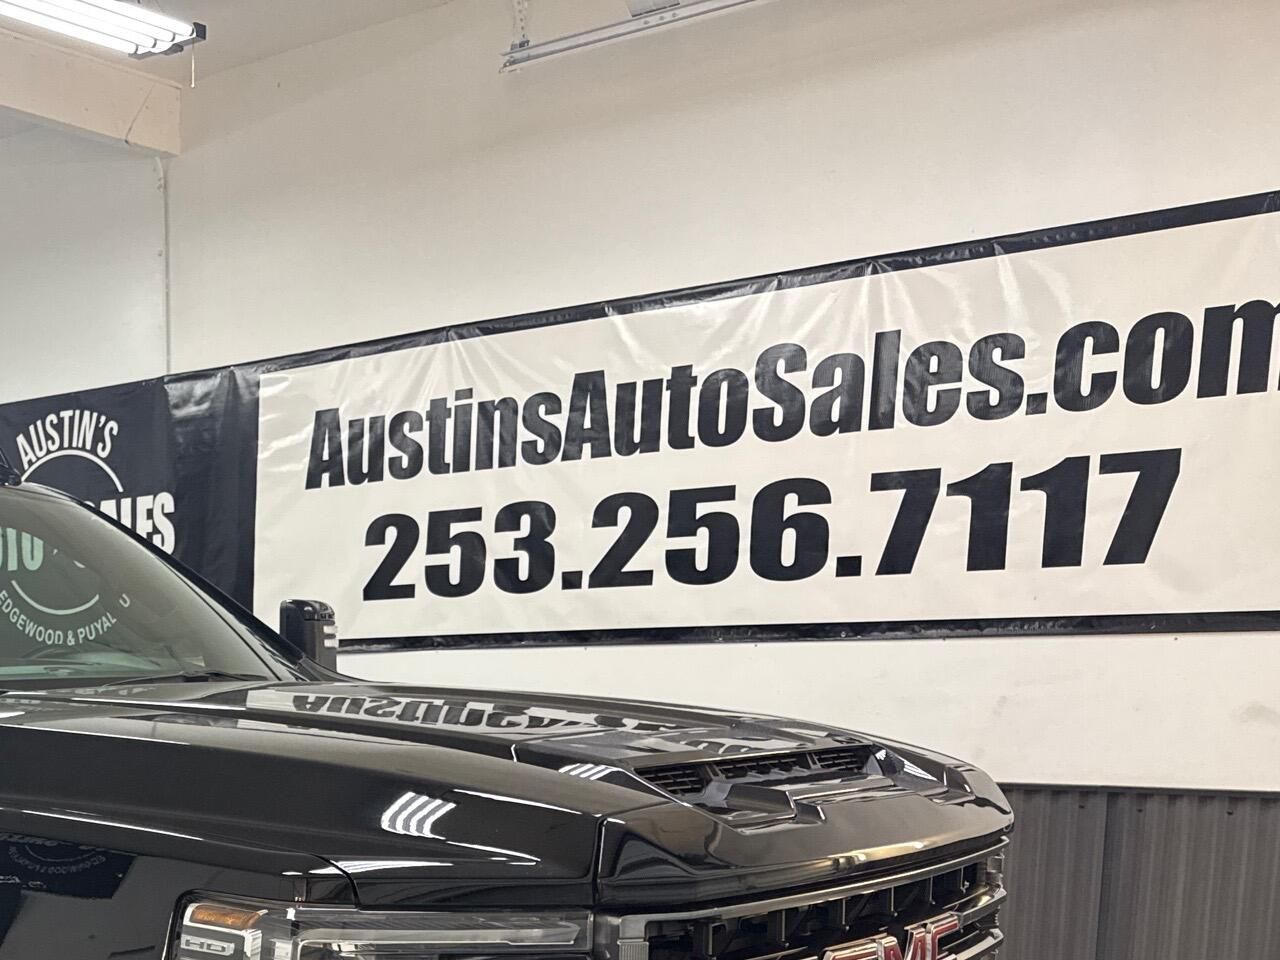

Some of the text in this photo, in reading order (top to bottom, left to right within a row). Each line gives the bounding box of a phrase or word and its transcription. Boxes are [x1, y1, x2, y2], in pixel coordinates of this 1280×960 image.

[305, 299, 1280, 491] AustinsAutoSales.com
[16, 409, 118, 470] AUSTIN'S
[362, 446, 1181, 601] 253.256.7117
[67, 630, 75, 645] &
[77, 593, 131, 645] PUYALU
[181, 934, 235, 956] HD
